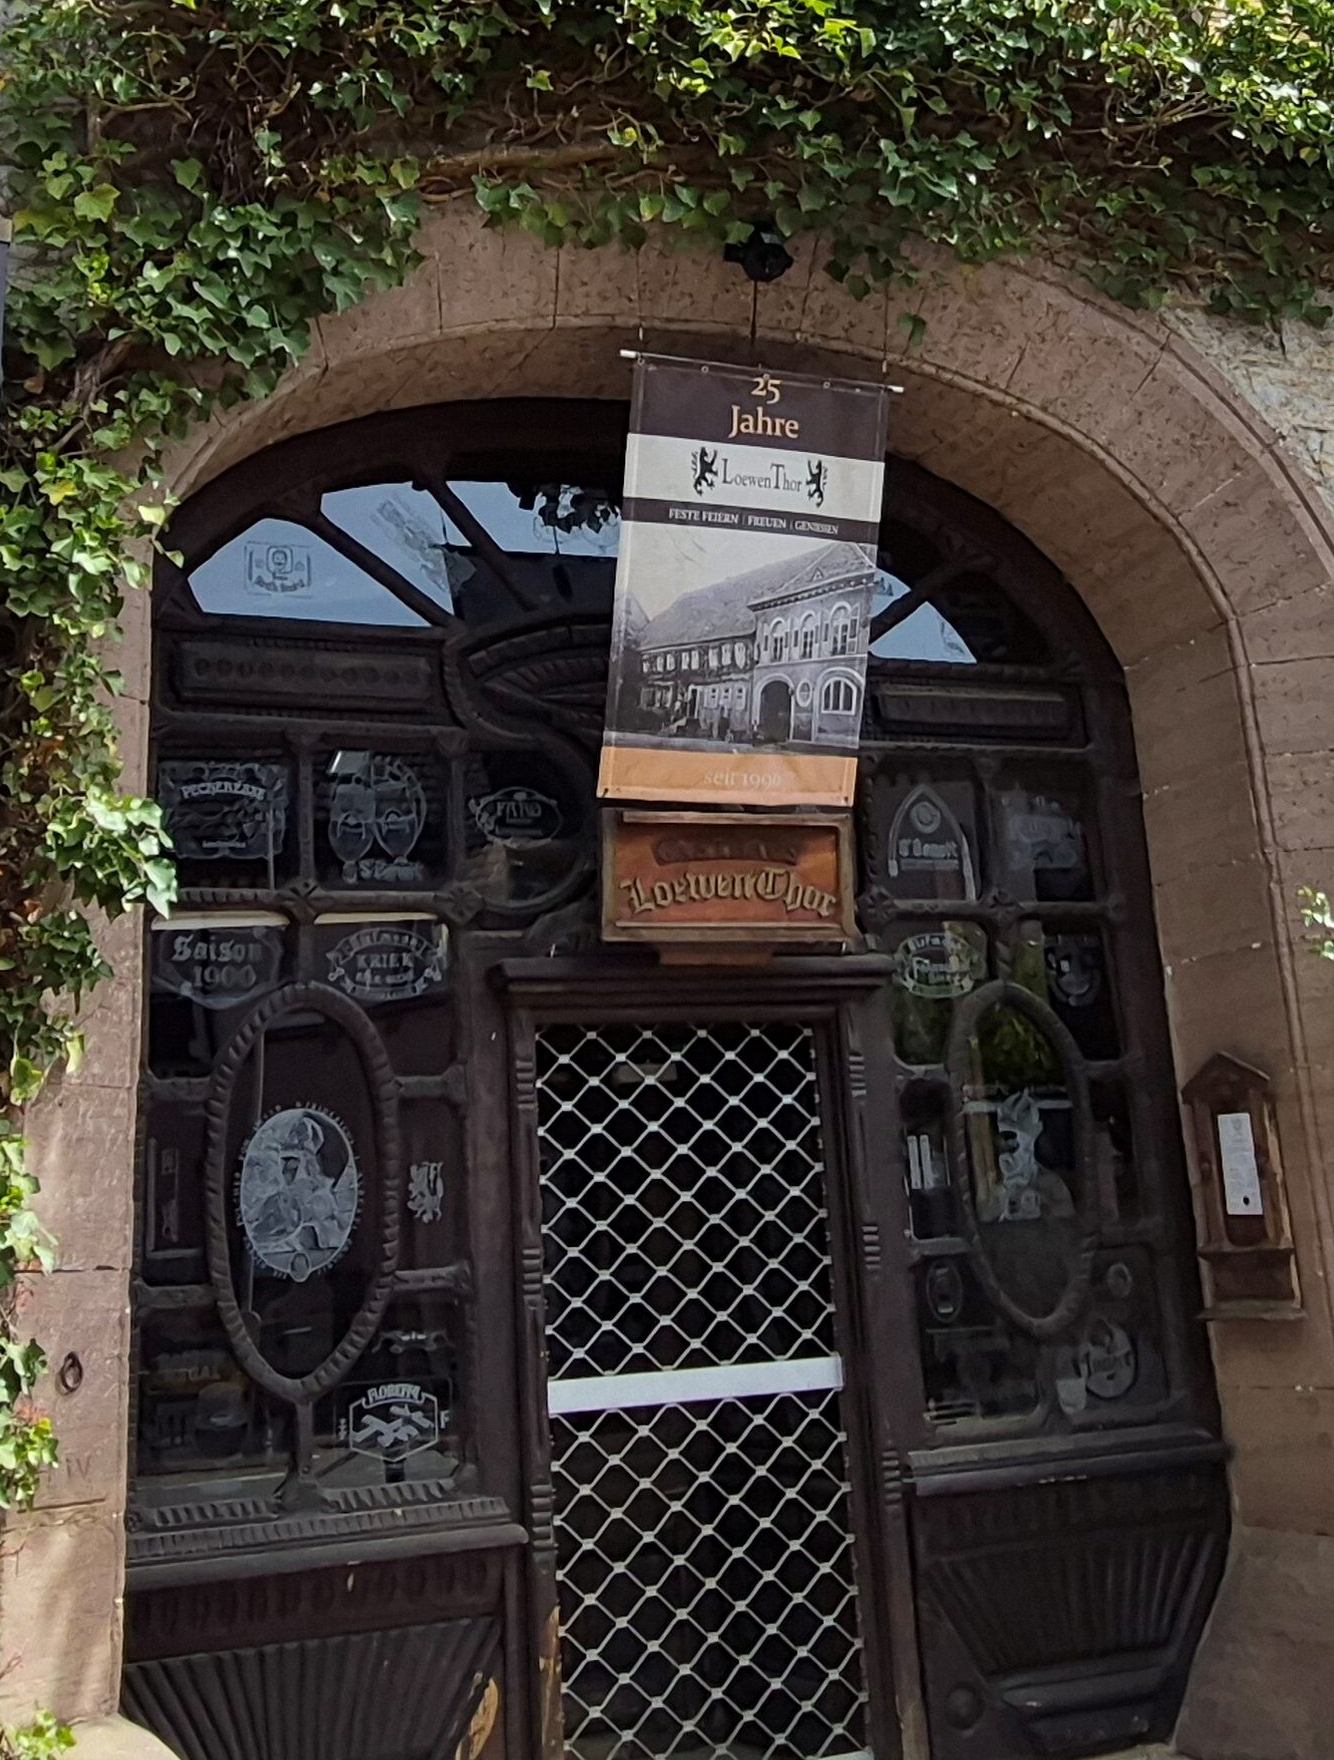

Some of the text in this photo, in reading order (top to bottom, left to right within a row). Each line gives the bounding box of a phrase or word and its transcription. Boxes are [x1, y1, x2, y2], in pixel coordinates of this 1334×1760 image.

[750, 376, 783, 405] 25
[728, 404, 800, 439] Jahre
[668, 507, 700, 522] FESTE
[701, 510, 739, 526] FEIERN
[747, 514, 787, 530] FREUEN
[172, 933, 262, 962] Saison
